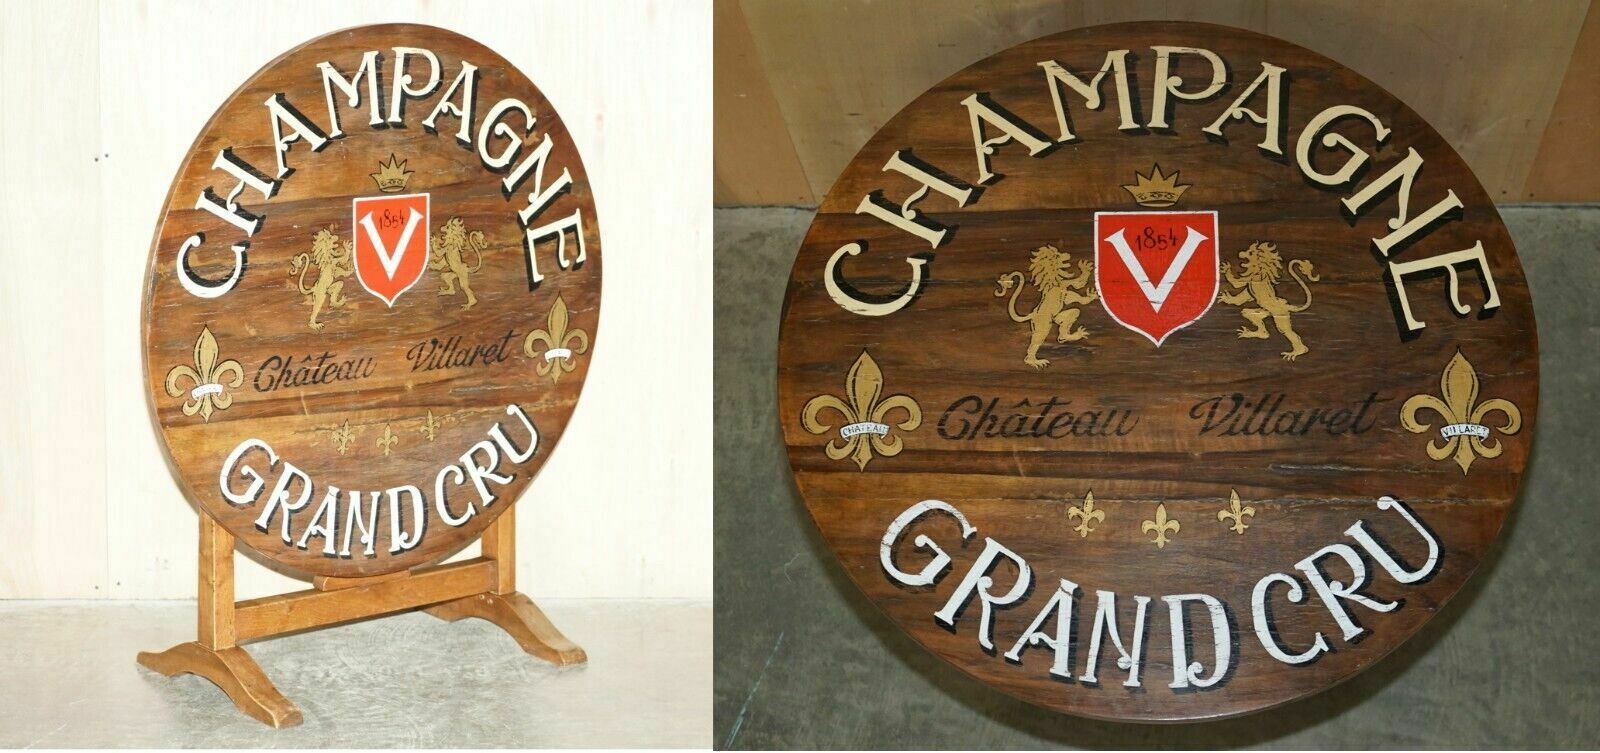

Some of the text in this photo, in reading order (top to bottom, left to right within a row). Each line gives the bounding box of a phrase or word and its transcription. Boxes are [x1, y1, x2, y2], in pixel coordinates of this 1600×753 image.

[176, 46, 587, 299] CHAMPAGNE
[824, 45, 1501, 332] CHAMPAGNE
[358, 206, 424, 282] V
[378, 208, 404, 230] 1854
[1135, 226, 1178, 251] 1854
[1103, 225, 1209, 314] V
[253, 328, 522, 393] Château Villaret
[937, 391, 1400, 441] Château Villaret
[219, 404, 540, 558] GRAND CRU
[879, 495, 1440, 690] GRAND CRU
